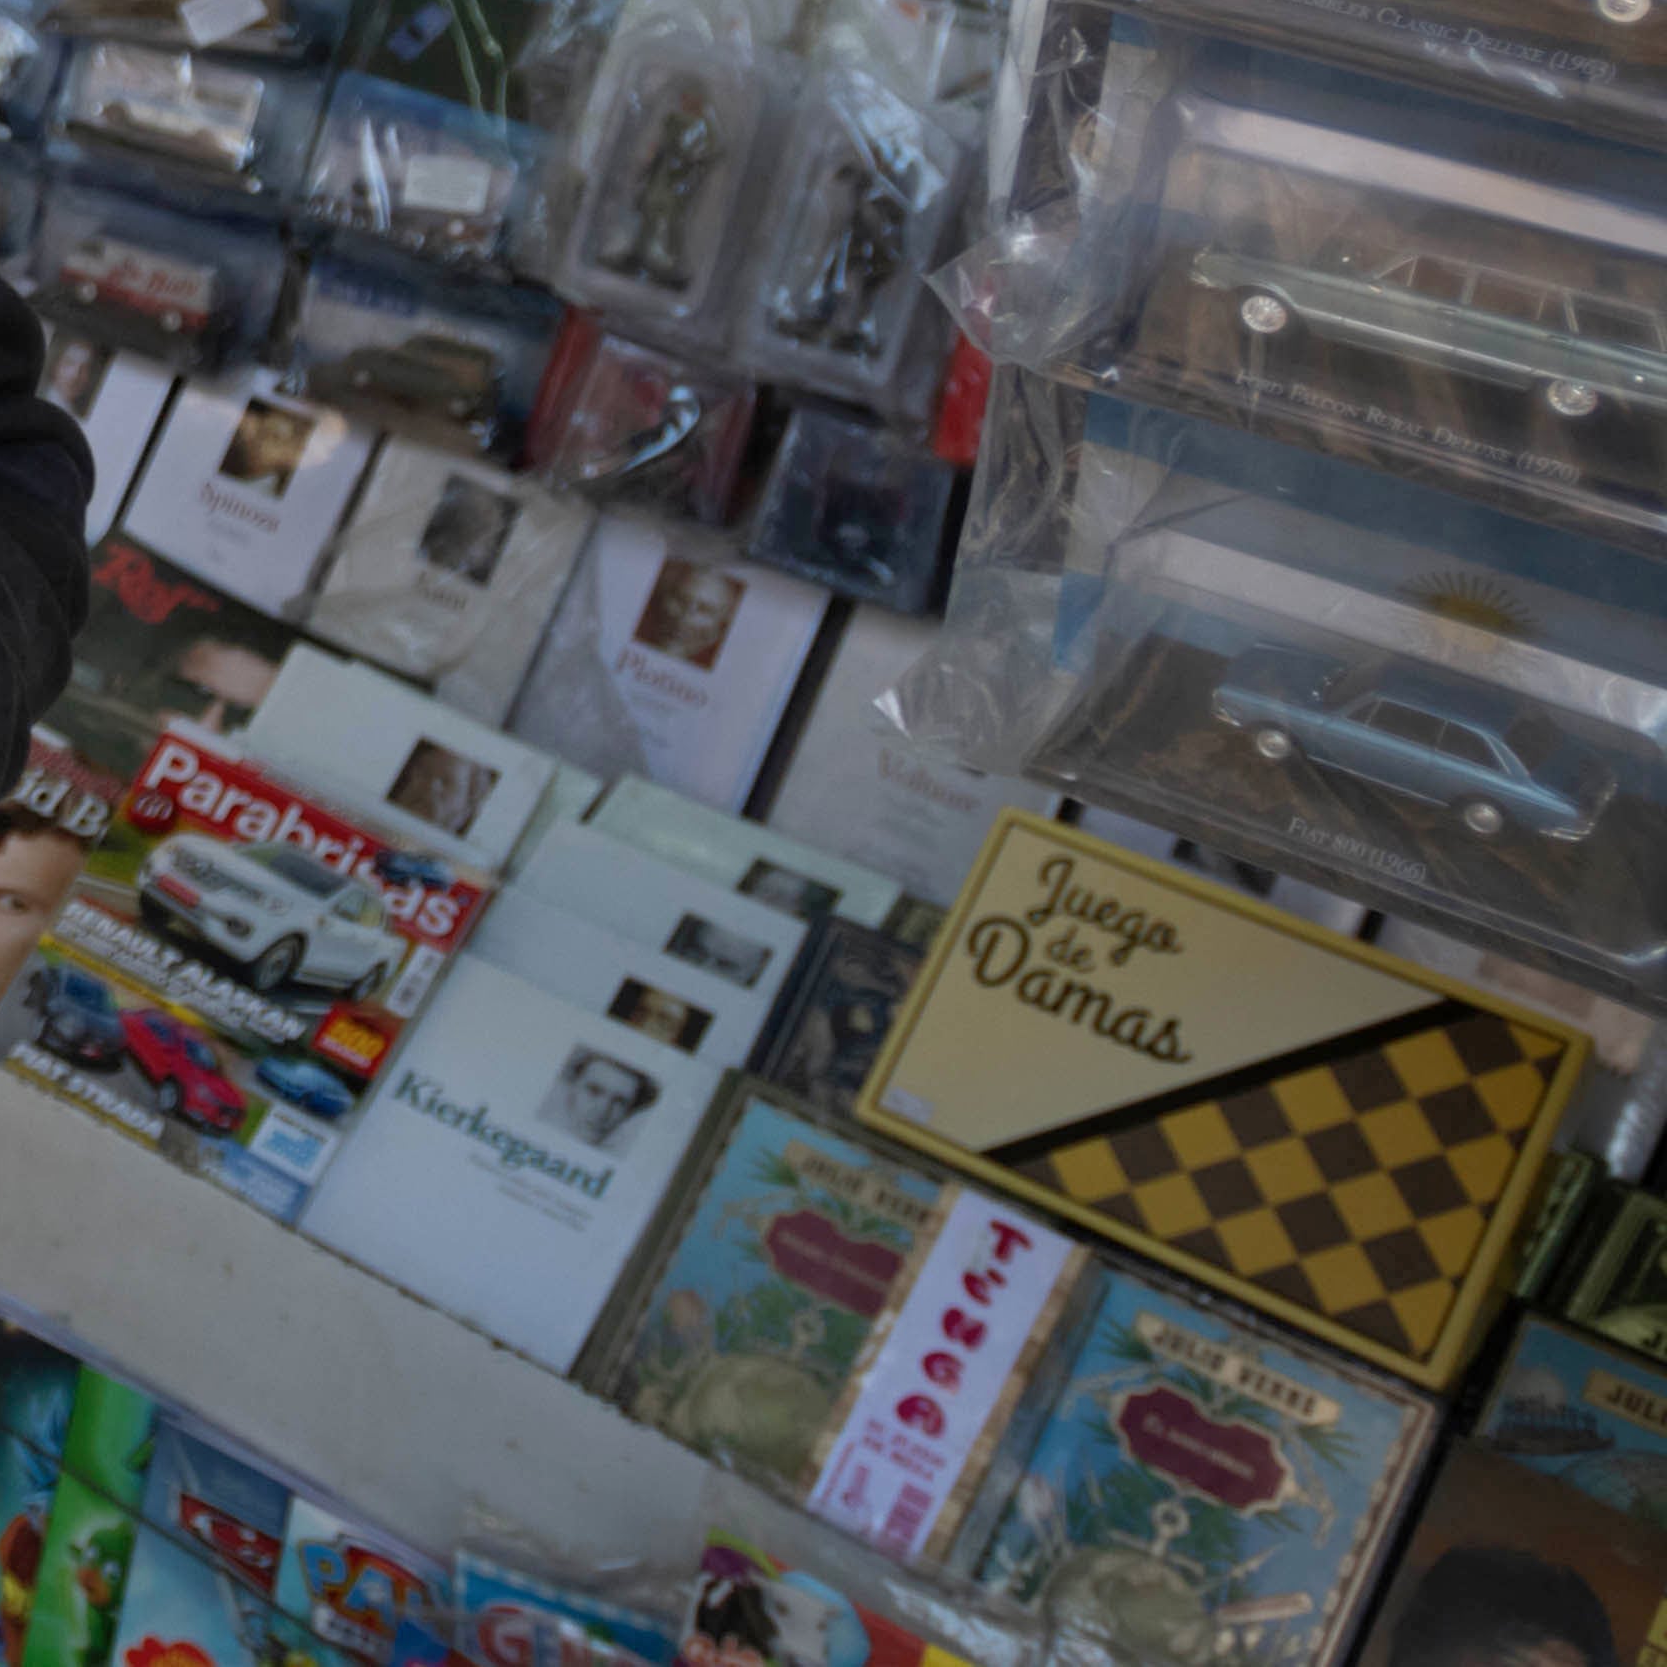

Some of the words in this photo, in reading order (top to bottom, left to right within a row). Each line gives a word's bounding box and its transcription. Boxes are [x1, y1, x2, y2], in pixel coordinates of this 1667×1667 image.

[1376, 7, 1458, 43] CLASSIC
[1460, 28, 1548, 63] DELUXE
[1289, 382, 1365, 418] FALCON
[197, 480, 282, 534] Spinoza
[1286, 815, 1333, 848] FIAT
[1329, 832, 1369, 859] 800
[1369, 845, 1428, 884] (1966)
[1023, 852, 1186, 970] Juego
[63, 898, 179, 977] RENAULT
[178, 958, 309, 1045] ALASKAN
[1044, 924, 1096, 974] de
[966, 913, 1193, 1064] Damas
[65, 1068, 167, 1143] STRADA
[392, 1067, 617, 1202] Kierkegaard
